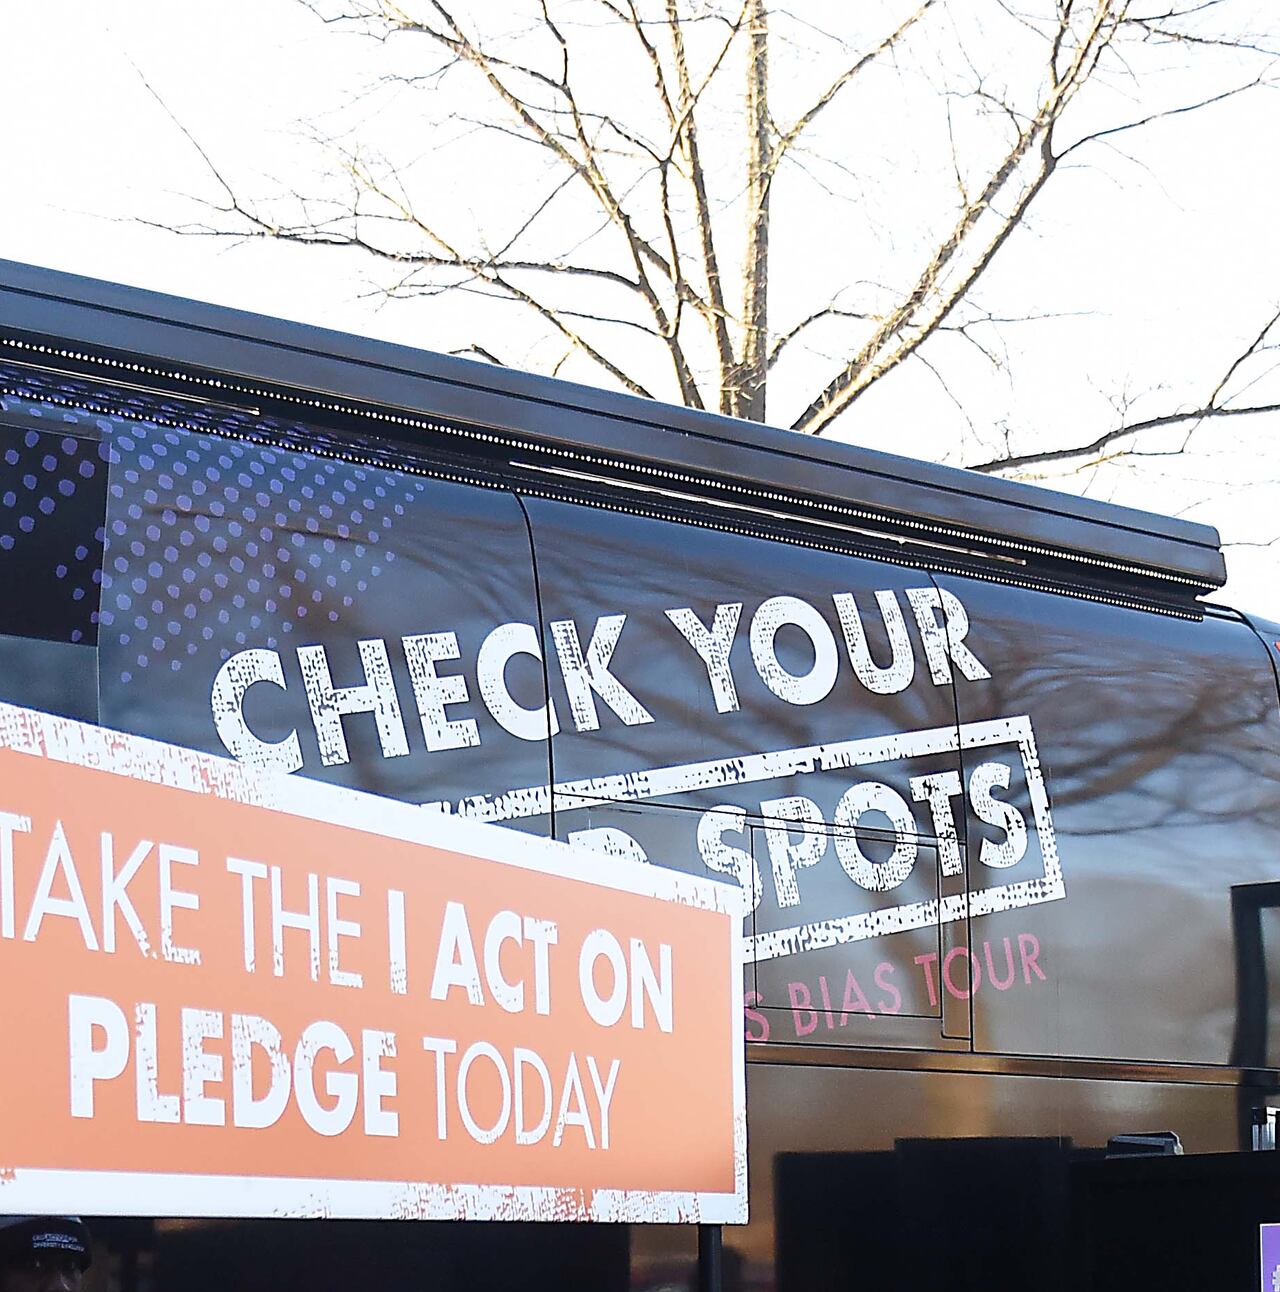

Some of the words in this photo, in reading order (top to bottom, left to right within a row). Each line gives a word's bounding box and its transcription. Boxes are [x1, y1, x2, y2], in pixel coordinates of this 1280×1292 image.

[211, 614, 654, 774] CHECK
[664, 586, 992, 713] YOUR
[696, 762, 1028, 917] SPOTS
[226, 857, 363, 988] THE
[388, 888, 408, 995] I
[430, 901, 558, 1016] ACT
[578, 928, 673, 1035] ON
[788, 961, 903, 1038] BIAS
[915, 933, 1046, 1008] TOUR
[68, 994, 399, 1138] PLEDGE
[423, 1036, 621, 1150] TODAY
